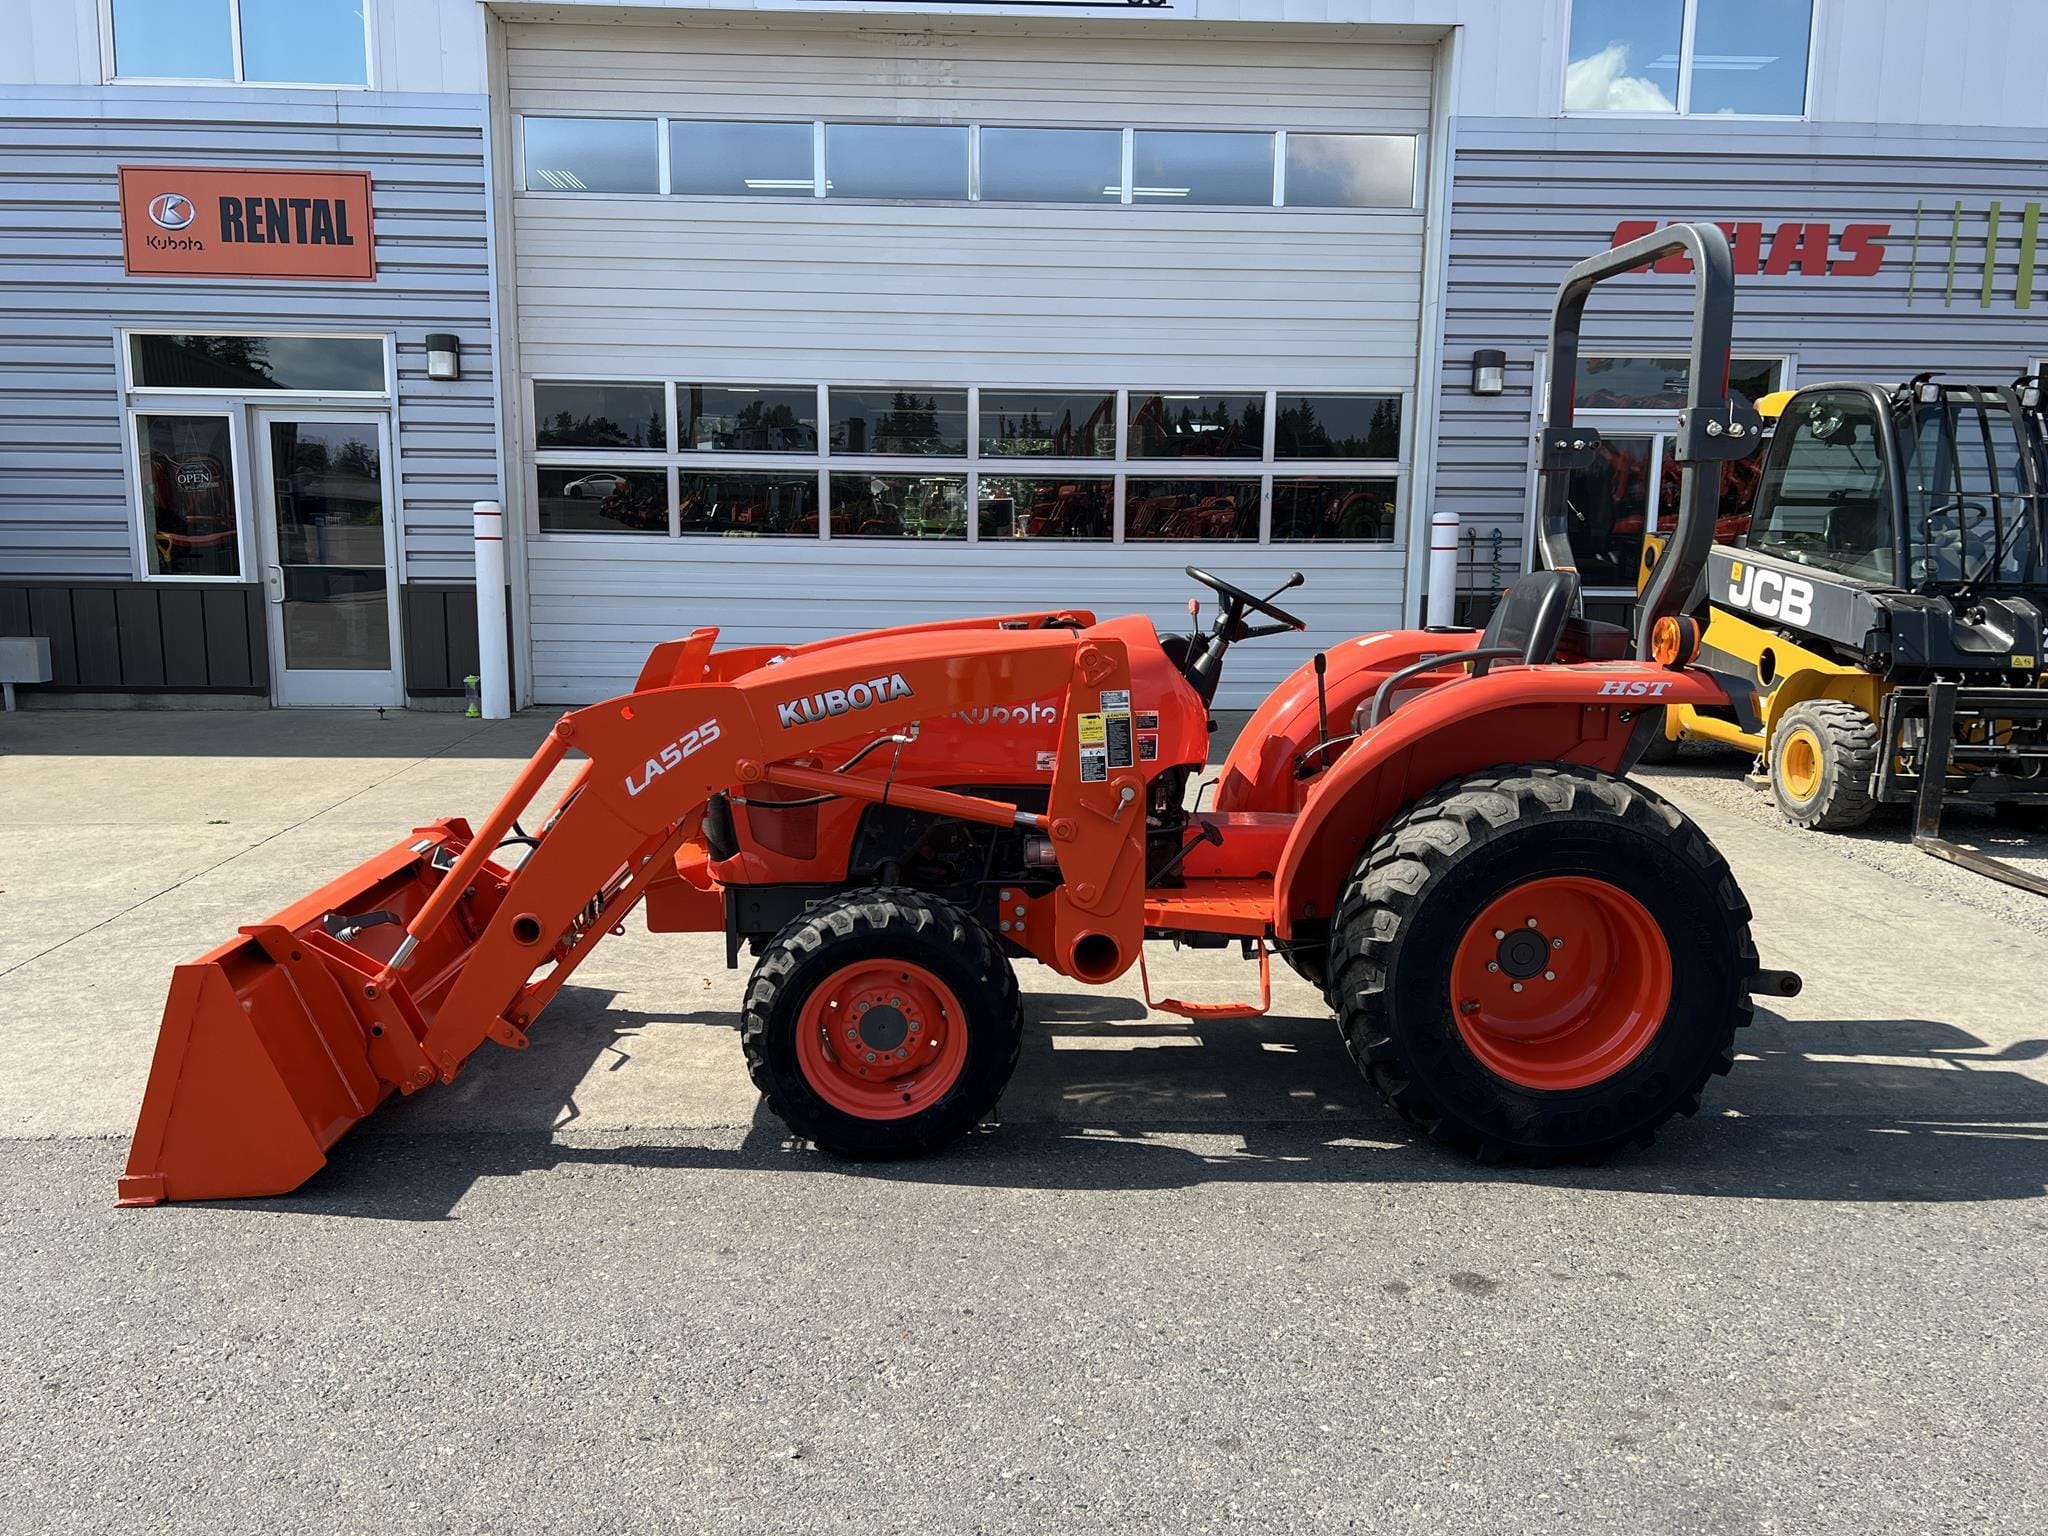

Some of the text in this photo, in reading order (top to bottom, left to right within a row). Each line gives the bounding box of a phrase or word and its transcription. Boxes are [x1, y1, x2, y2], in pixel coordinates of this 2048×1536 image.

[146, 235, 203, 250] Kubota
[218, 196, 354, 246] RENTAL
[177, 473, 209, 483] OPEN
[1728, 565, 1814, 627] JCB
[777, 672, 914, 729] KUBOTA
[1597, 680, 1672, 696] HST
[625, 718, 721, 796] LA525
